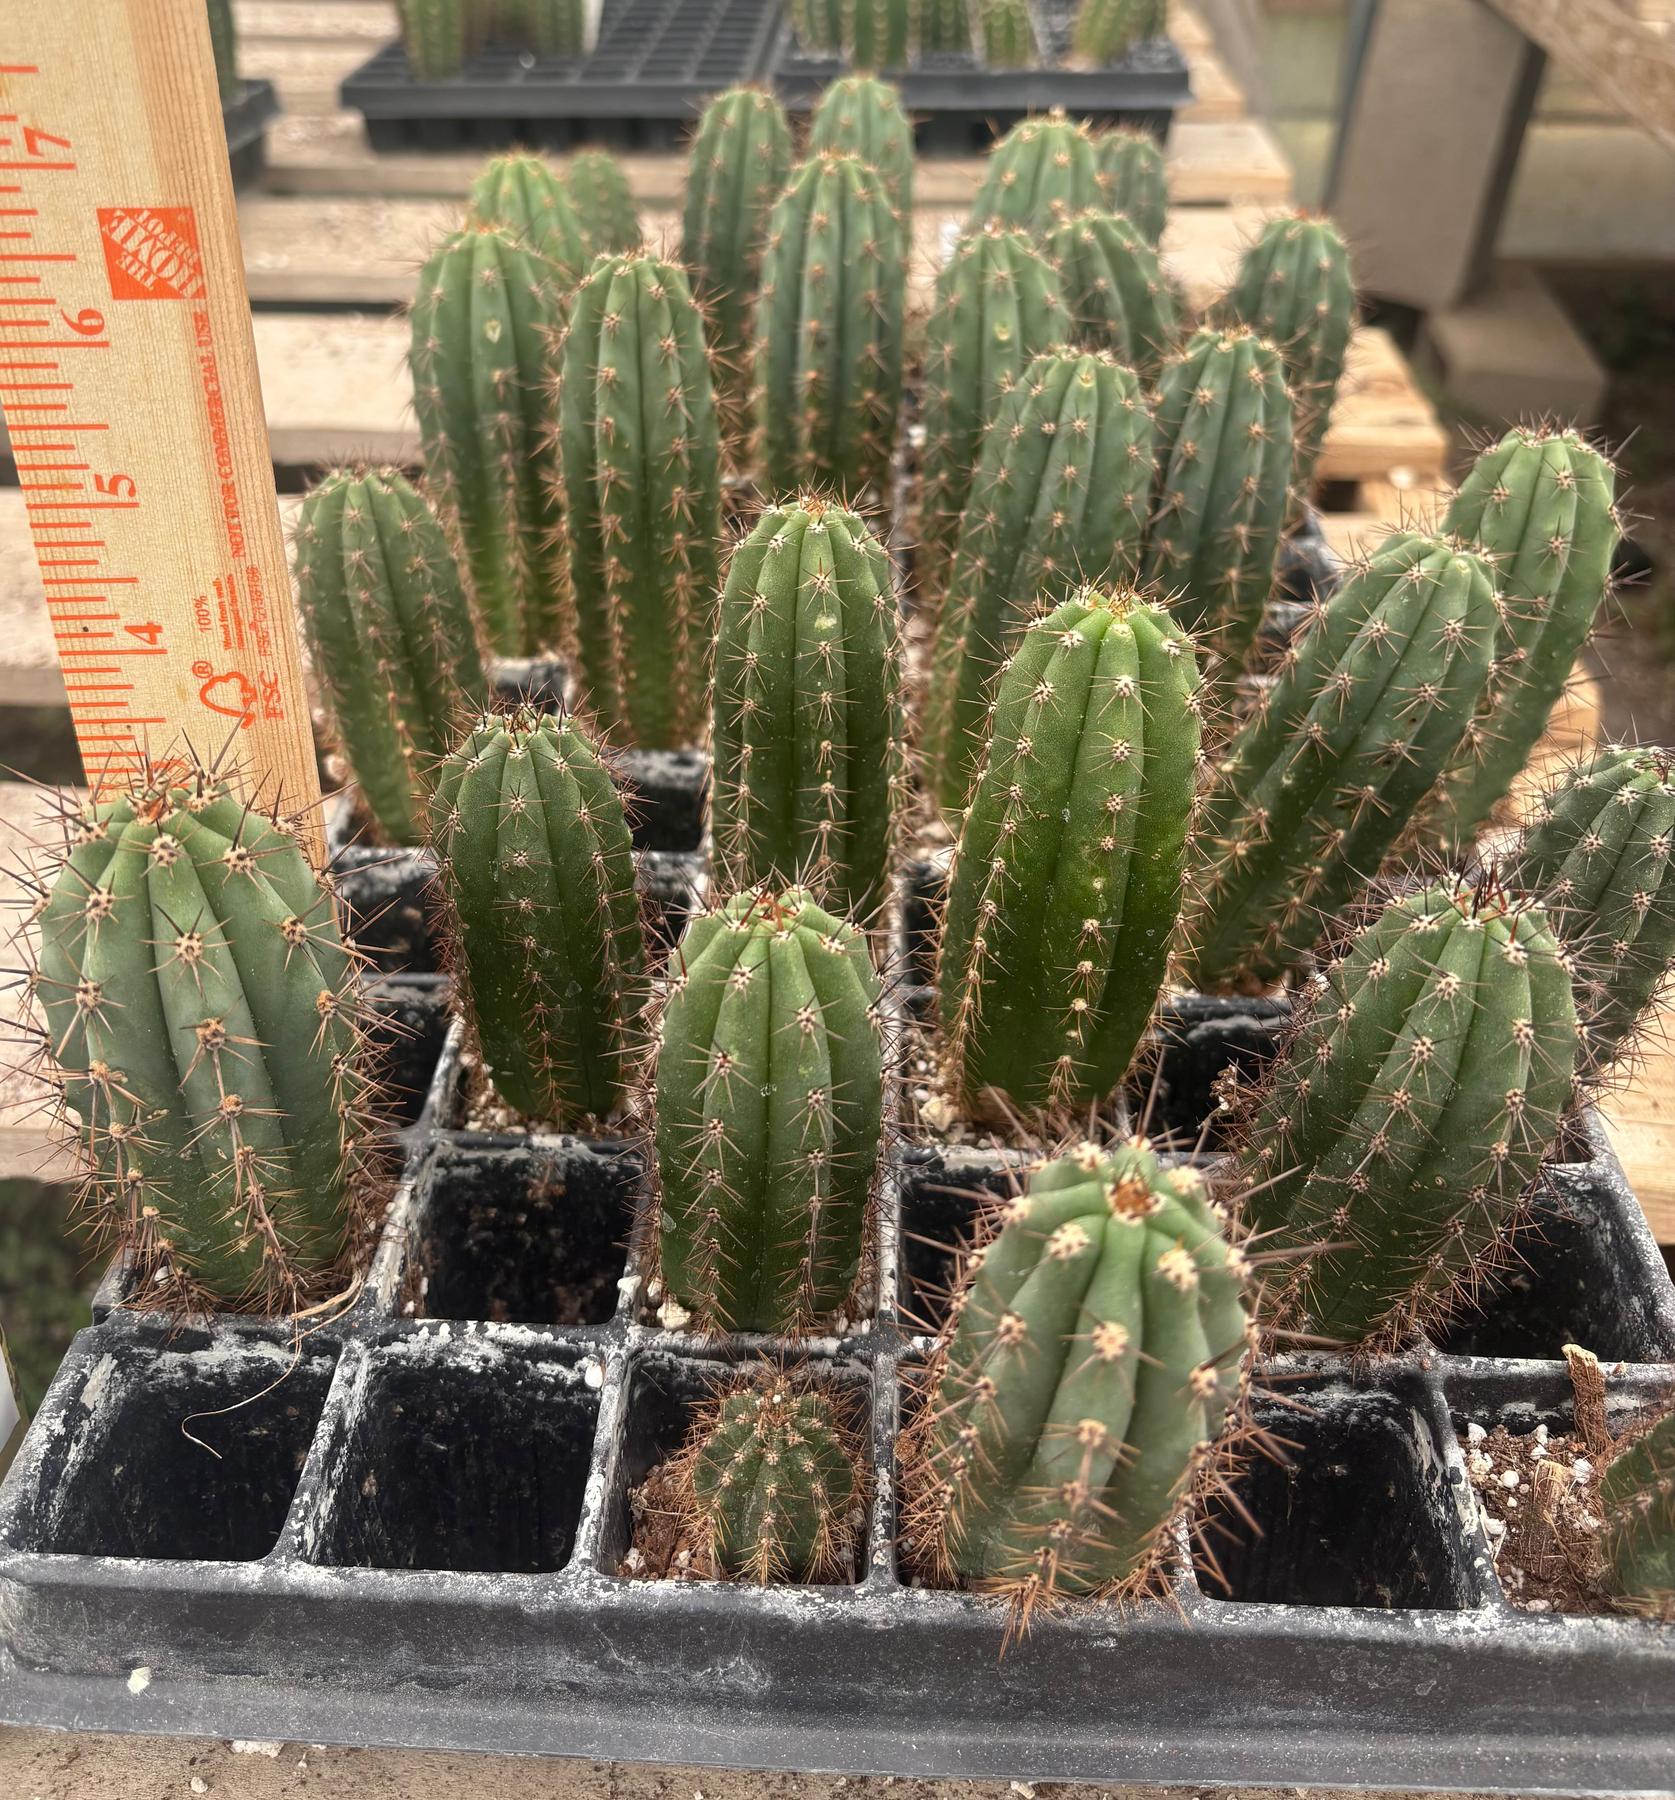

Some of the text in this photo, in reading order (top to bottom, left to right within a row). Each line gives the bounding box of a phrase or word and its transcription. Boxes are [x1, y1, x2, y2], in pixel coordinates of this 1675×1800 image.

[22, 125, 72, 157] 7
[102, 209, 201, 298] HOME
[134, 209, 198, 272] DEPOT
[116, 251, 154, 290] THE
[60, 308, 105, 336] 6
[193, 311, 212, 347] USE
[94, 473, 137, 498] 5
[227, 520, 246, 559] NOT
[194, 595, 212, 632] 100%
[123, 621, 163, 645] 4
[259, 670, 284, 720] FSC
